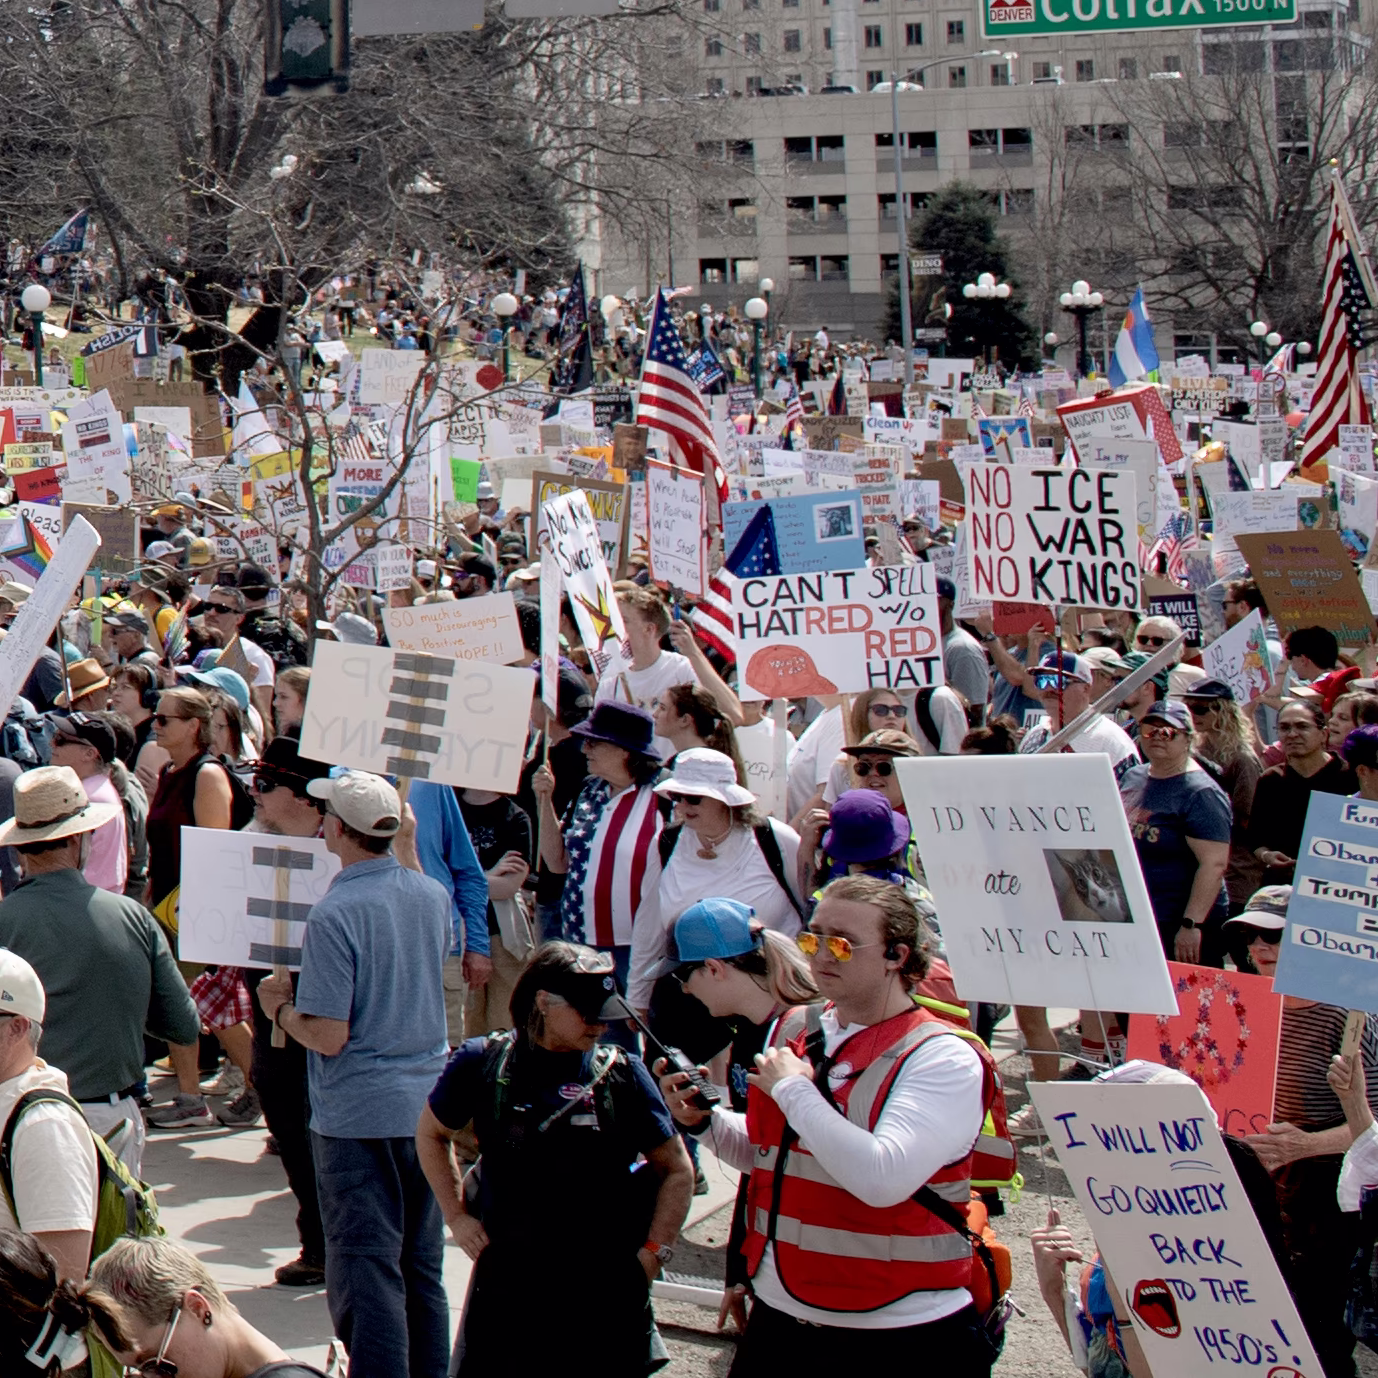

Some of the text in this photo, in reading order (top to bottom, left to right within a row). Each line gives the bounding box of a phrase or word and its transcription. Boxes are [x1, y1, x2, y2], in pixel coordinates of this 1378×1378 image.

[989, 7, 1032, 22] DENVER
[1180, 377, 1216, 389] ELVIS
[867, 417, 913, 433] Clean Up
[343, 468, 383, 482] MORE
[868, 458, 891, 469] BEING
[757, 477, 793, 488] HISTORY
[855, 473, 885, 484] TRICKED
[970, 466, 1120, 514] NO ICE
[862, 495, 891, 505] TO HATE
[973, 512, 1125, 558] NO WAR
[744, 565, 935, 607] CAN'T SPELL
[975, 556, 1139, 610] NO KINGS
[738, 604, 873, 639] HATRED
[1167, 600, 1195, 614] WILL
[865, 626, 937, 659] RED
[866, 656, 940, 688] HAT
[930, 805, 1096, 834] JD VANCE
[984, 868, 1021, 896] ate
[980, 927, 1110, 958] MY CAT
[1054, 1112, 1205, 1155] I WILL NOT
[1087, 1177, 1229, 1216] GO QUIETLY
[1150, 1233, 1242, 1267] BACK
[1166, 1278, 1256, 1305] TO THE
